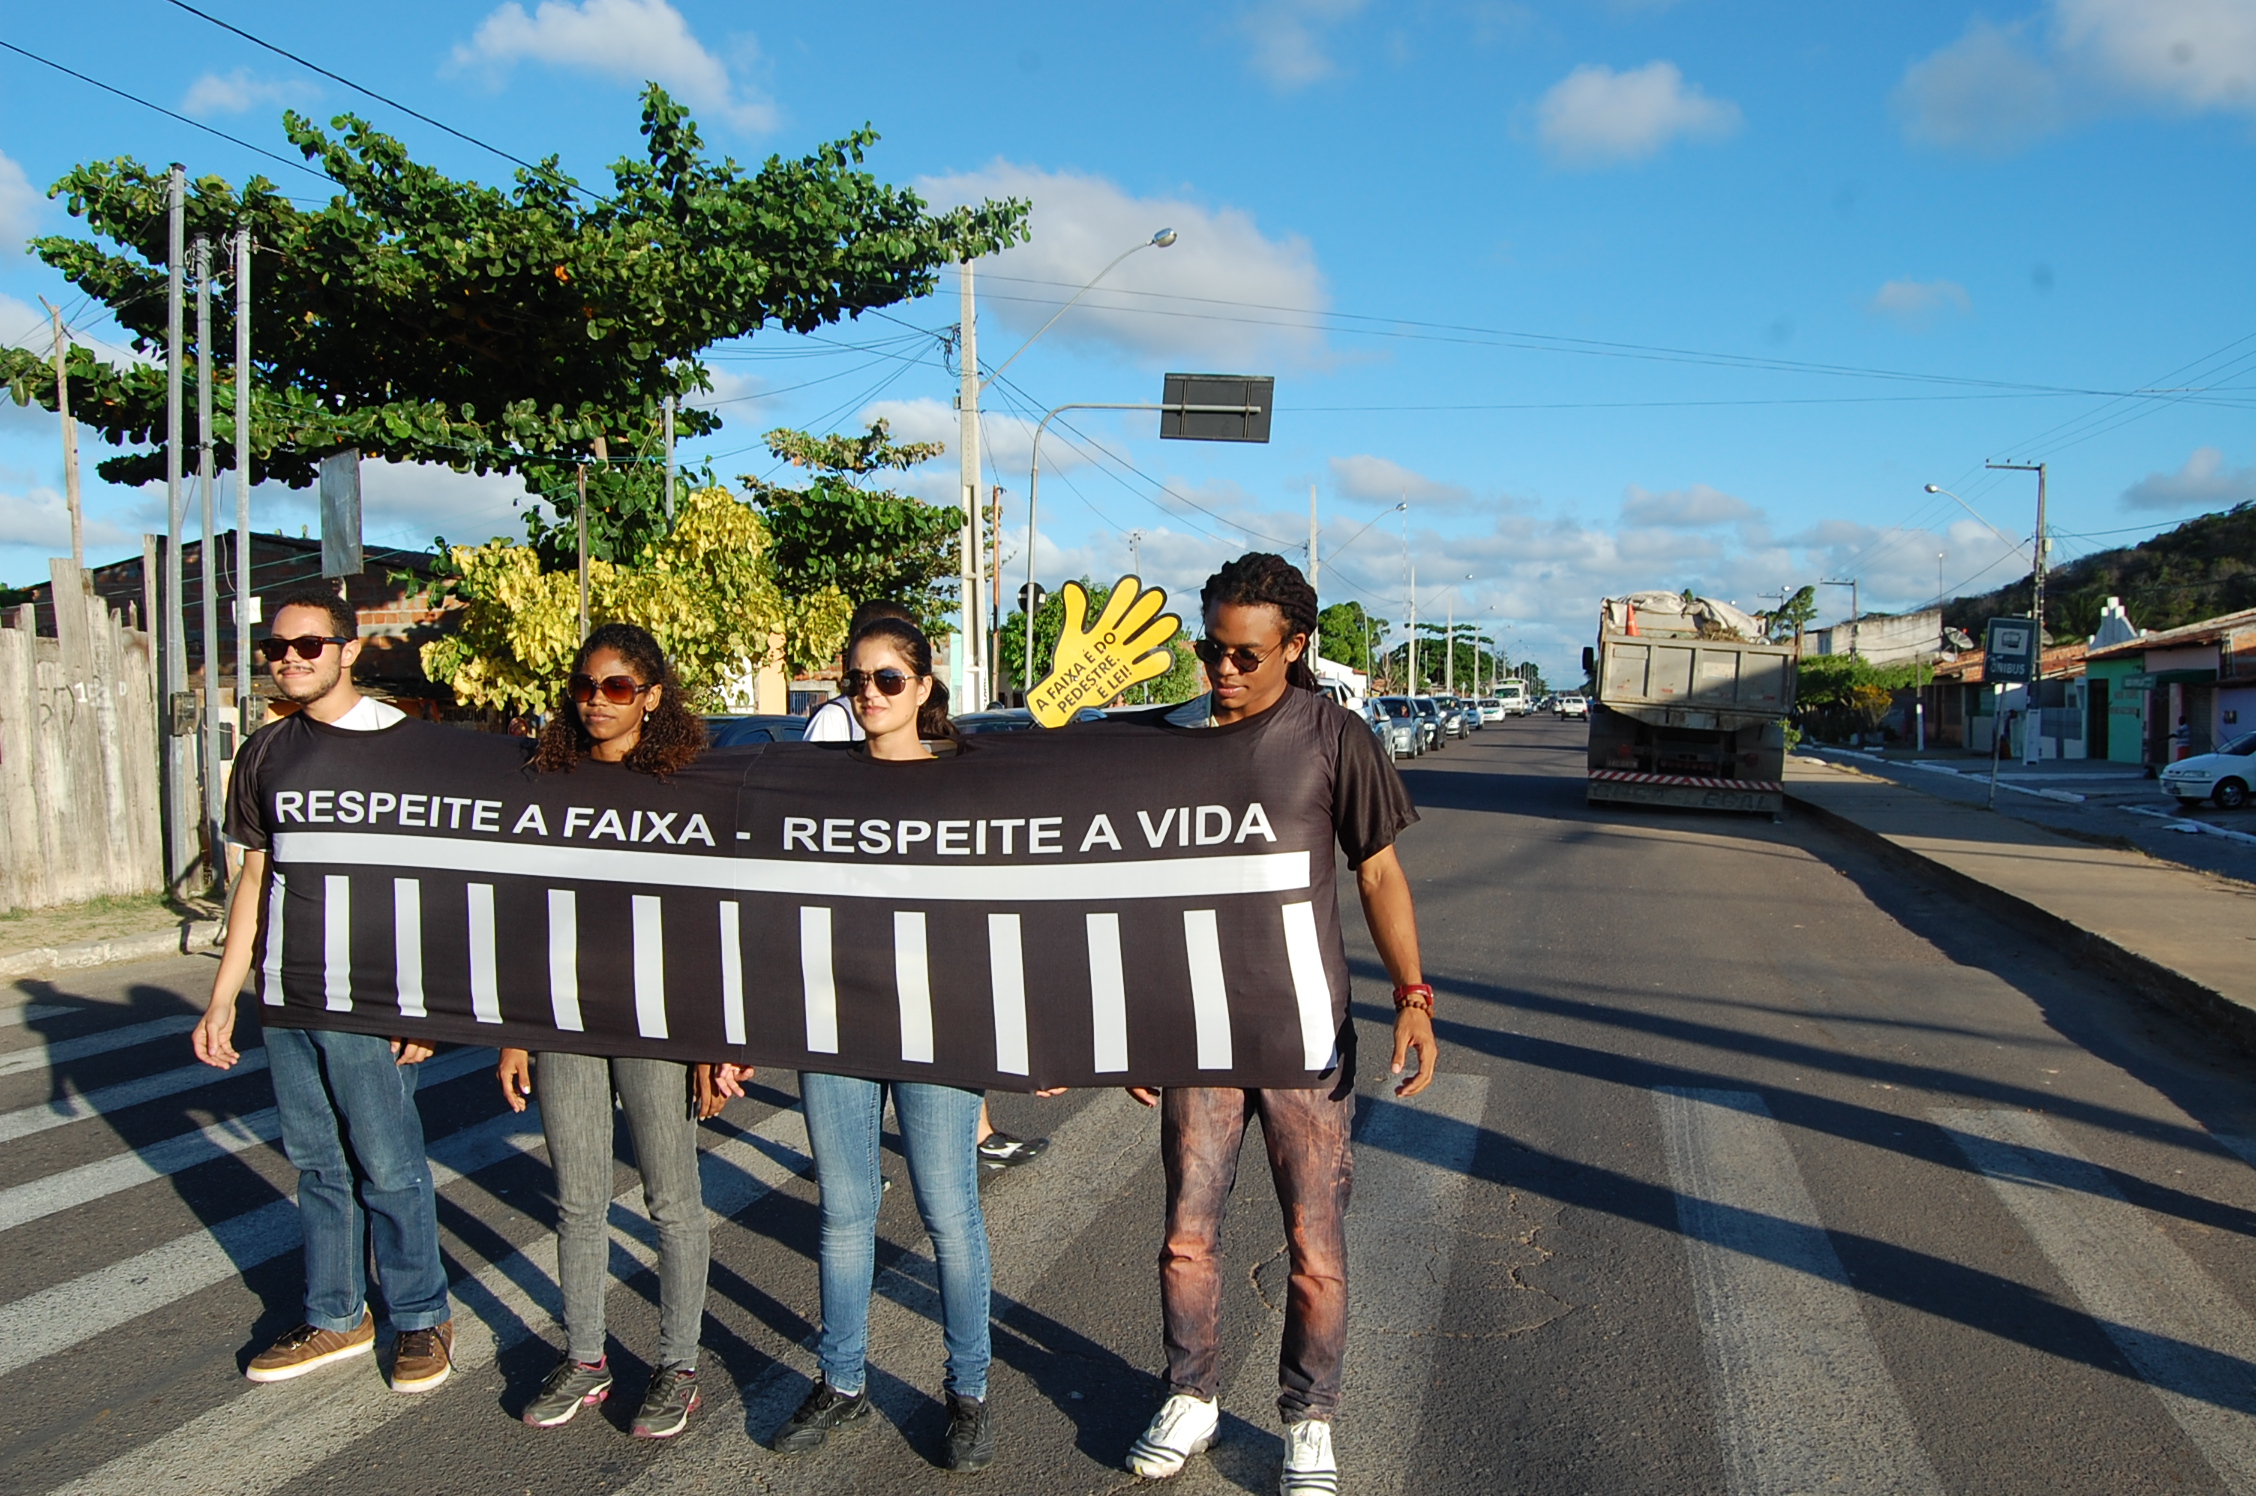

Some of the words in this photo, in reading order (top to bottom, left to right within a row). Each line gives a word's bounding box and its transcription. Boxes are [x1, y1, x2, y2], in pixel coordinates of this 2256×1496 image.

[1035, 697, 1049, 712] A
[1046, 662, 1087, 700] FAIXA
[1082, 648, 1096, 664] É
[1093, 632, 1116, 655] DO
[1057, 654, 1121, 713] PEDESTRE.
[1095, 684, 1109, 699] É
[1106, 664, 1133, 690] LEI!
[274, 790, 503, 832] RESPEITE
[512, 804, 549, 836] A
[563, 806, 716, 847] FAIXA
[736, 831, 751, 840] -
[783, 816, 1063, 855] RESPEITE
[1079, 813, 1123, 852] A
[1136, 802, 1278, 847] VIDA
